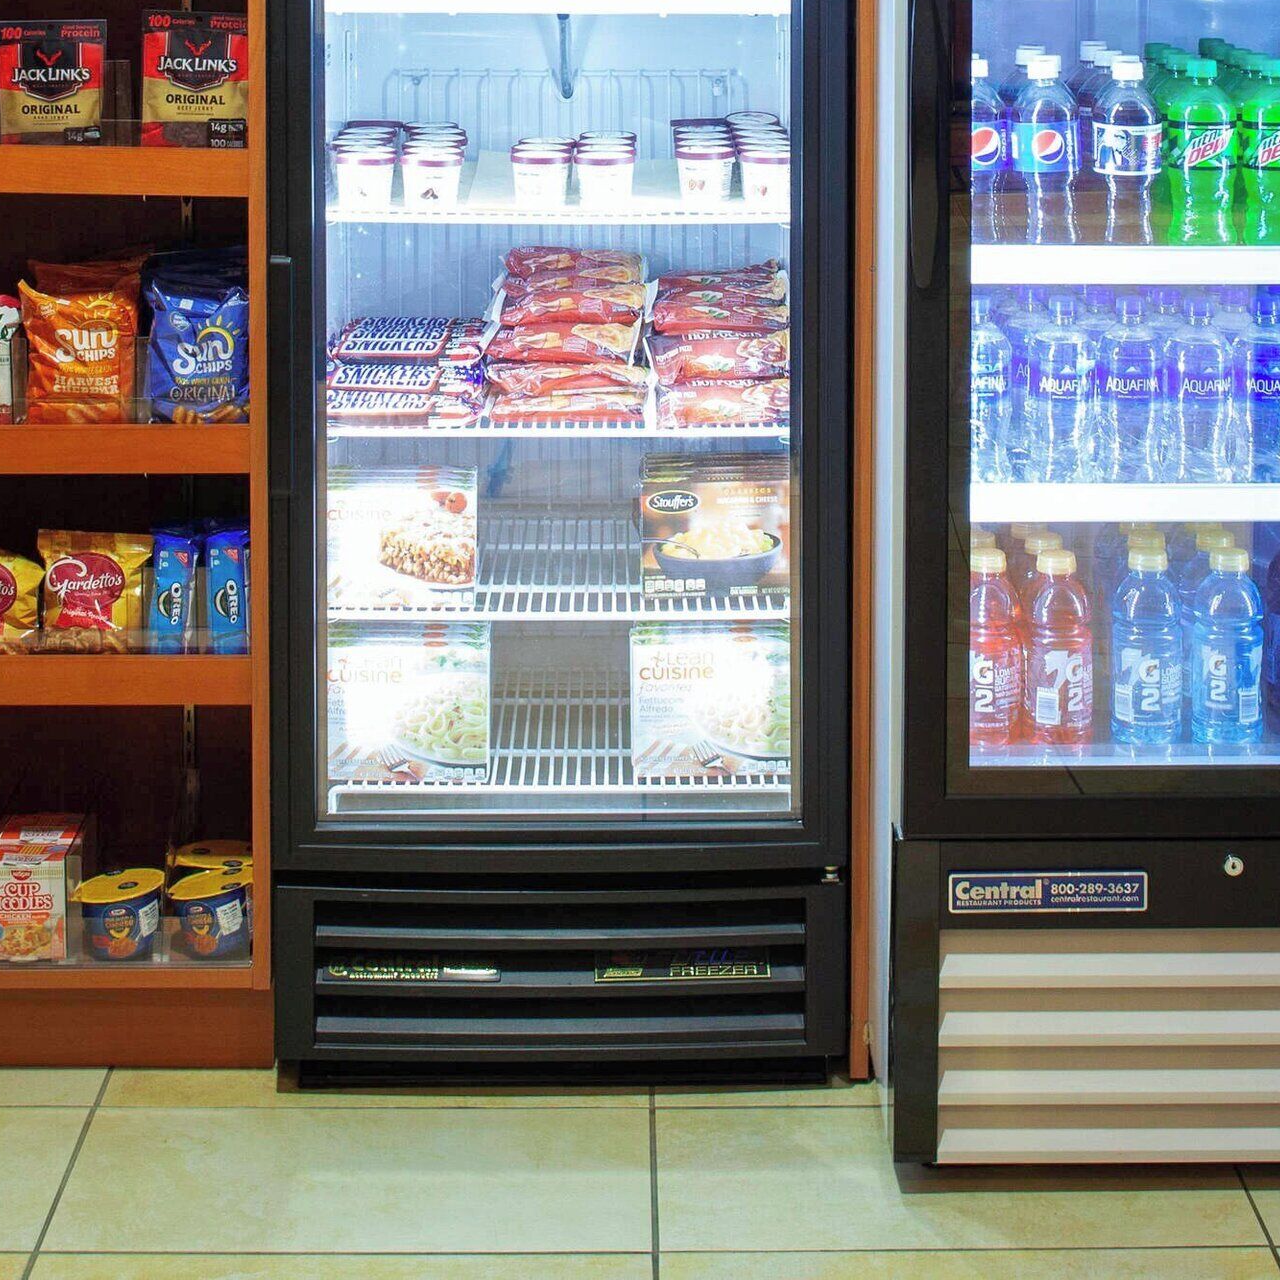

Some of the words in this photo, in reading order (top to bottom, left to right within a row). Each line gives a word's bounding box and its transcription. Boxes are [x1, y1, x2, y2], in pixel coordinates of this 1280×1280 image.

[149, 15, 170, 26] 100
[210, 19, 247, 29] Protein
[1, 27, 21, 39] 100
[61, 28, 100, 37] Protein
[158, 57, 191, 70] JACK
[195, 58, 237, 71] LINK'S
[12, 68, 45, 81] JACK
[49, 69, 90, 81] LINK'S
[166, 94, 225, 105] ORIGINAL
[22, 104, 80, 114] ORIGINAL
[211, 123, 227, 132] 14g
[211, 139, 225, 147] 100
[1192, 131, 1217, 148] mtn
[55, 327, 117, 362] Sun
[78, 348, 115, 361] CHIPS
[173, 337, 233, 374] Sun
[195, 360, 232, 373] CHIPS
[55, 375, 118, 386] HARVEST
[336, 366, 434, 386] SNICKERS
[54, 385, 119, 394] CHEDDAR
[1106, 377, 1159, 394] AQUAFINA
[1183, 378, 1231, 394] AQUAFINA
[651, 495, 694, 508] Stouffer's
[46, 556, 122, 605] Gardetto's
[169, 582, 182, 625] OREO
[226, 579, 237, 624] OREO
[327, 669, 402, 683] cuisine
[640, 667, 714, 680] cuisine
[639, 705, 673, 713] Alfredo
[5, 882, 40, 897] CUP
[955, 879, 1042, 899] Central
[1051, 883, 1139, 894] 800-289-3637
[1051, 895, 1139, 903] centralrestaurant.com
[671, 965, 758, 976] FREEZER
